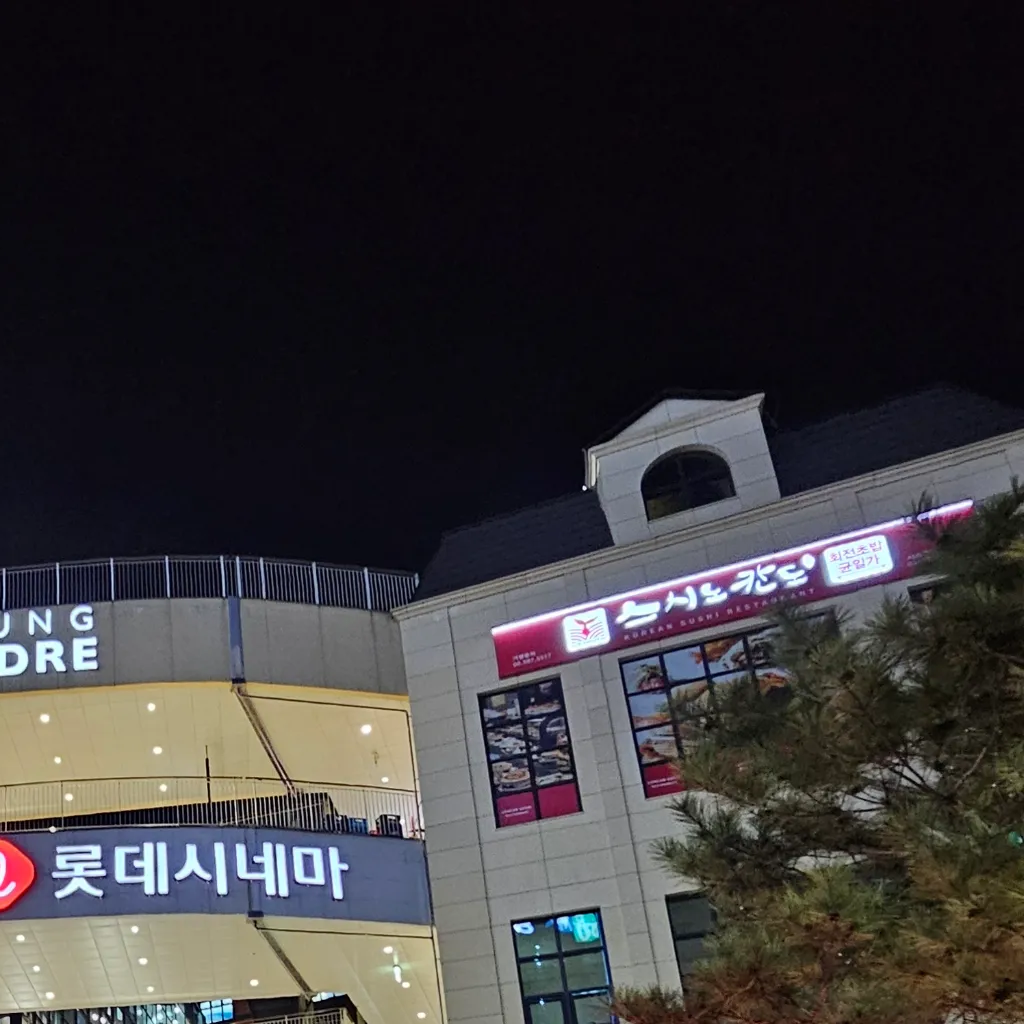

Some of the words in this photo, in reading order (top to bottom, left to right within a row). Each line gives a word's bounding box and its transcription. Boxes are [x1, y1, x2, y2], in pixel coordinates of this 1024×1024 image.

[829, 540, 883, 563] 회전초밥
[838, 554, 880, 574] 균일가
[615, 558, 817, 629] 스시노칸도
[622, 622, 674, 640] KOREAN
[679, 612, 720, 628] SUSHI
[53, 842, 351, 904] 롯데시네마
